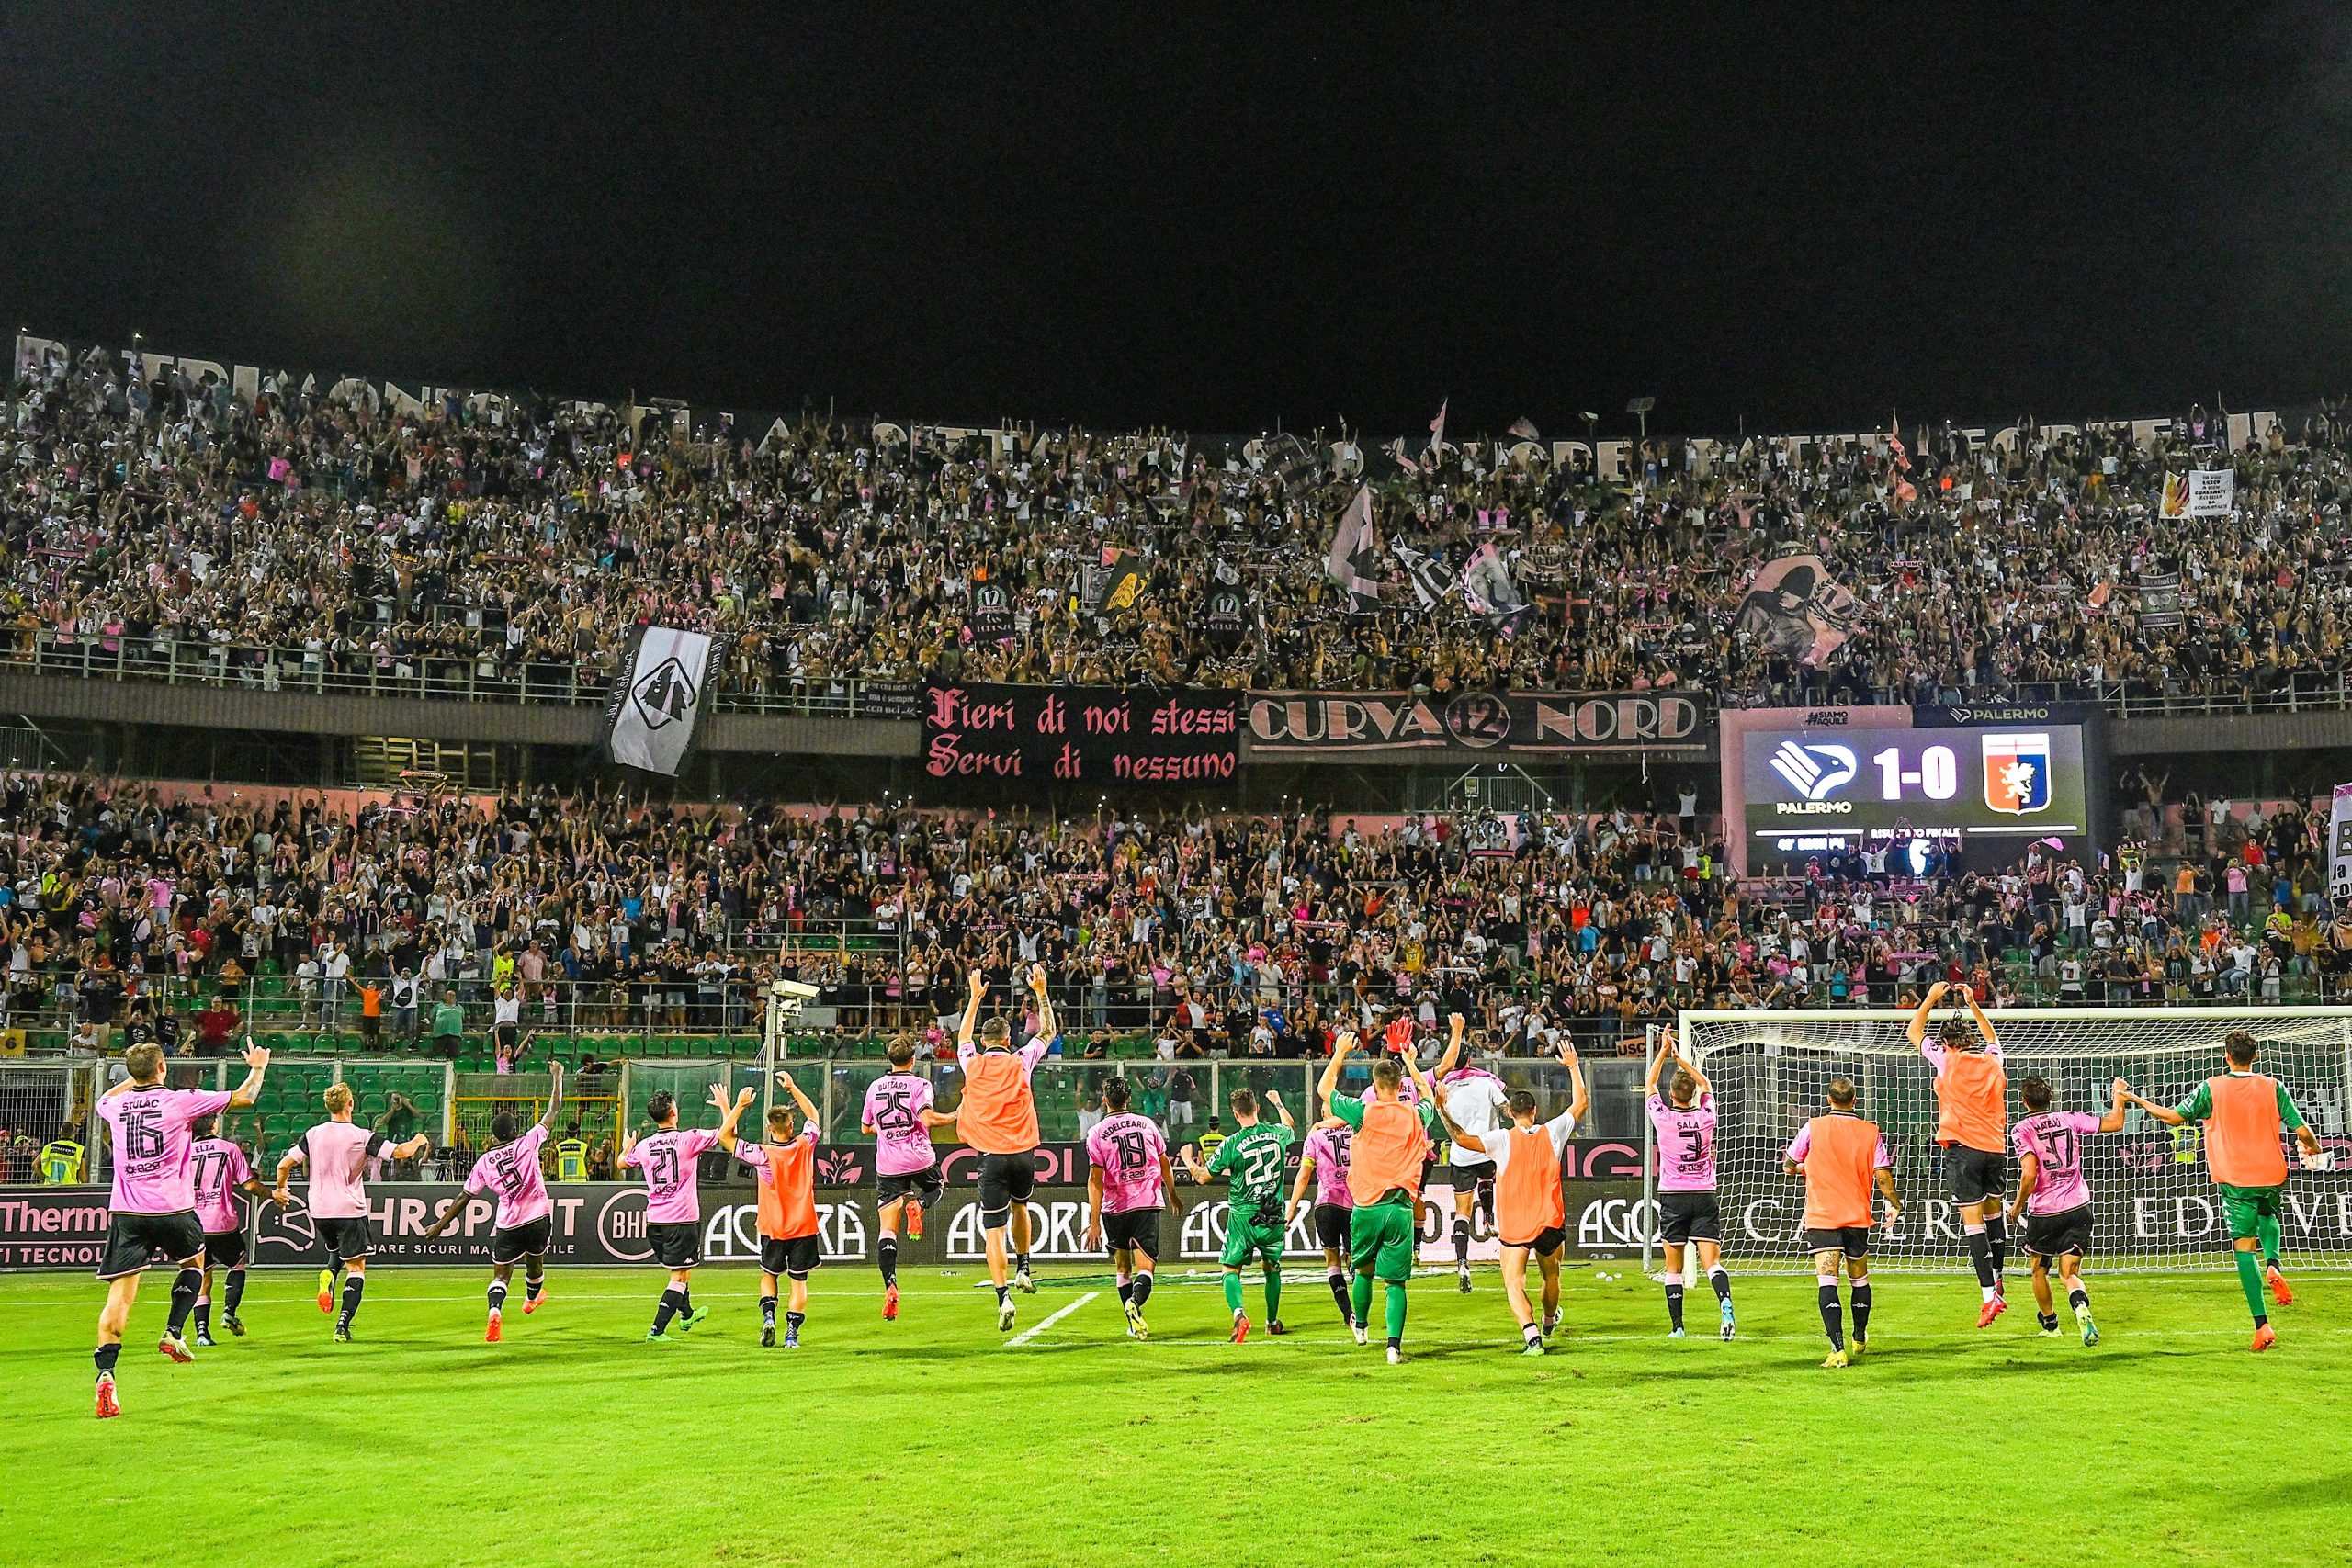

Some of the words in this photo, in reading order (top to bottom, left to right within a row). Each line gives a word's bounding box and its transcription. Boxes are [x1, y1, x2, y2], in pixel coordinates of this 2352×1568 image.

[983, 590, 1001, 606] 12
[1219, 598, 1235, 614] 12
[865, 705, 883, 713] con
[888, 695, 915, 705] sempre
[926, 686, 1015, 730] Fieri
[1037, 694, 1067, 734] di
[1083, 700, 1131, 735] noi
[1151, 696, 1236, 735] stessi
[1973, 708, 2049, 720] PALERMO
[1250, 698, 1444, 741] CURVA
[1536, 698, 1697, 742] NORD
[1817, 717, 1849, 726] AQUILE
[926, 734, 1023, 777] Servi
[1054, 741, 1082, 779] di
[1113, 751, 1236, 780] nessuno
[1873, 745, 1957, 801] 1-0
[1776, 801, 1853, 815] PALERMO
[6, 1037, 17, 1050] 6
[1617, 1039, 1659, 1056] USCT
[875, 1091, 914, 1131] 25
[1677, 1122, 1700, 1130] SALA
[119, 1111, 164, 1161] 16
[1101, 1121, 1148, 1141] NEDELCEARU
[1679, 1130, 1702, 1162] 3
[195, 1145, 216, 1154] ELIA
[489, 1147, 515, 1165] GOME
[1111, 1131, 1147, 1170] 18
[1241, 1142, 1282, 1187] 22
[1328, 1133, 1352, 1168] 15
[2037, 1127, 2074, 1171] 37
[191, 1151, 229, 1192] 77
[496, 1156, 523, 1190] 5
[650, 1147, 680, 1185] 21
[0, 1201, 111, 1233] Therm
[1578, 1199, 1662, 1243] AGO
[414, 1244, 463, 1255] SICURI
